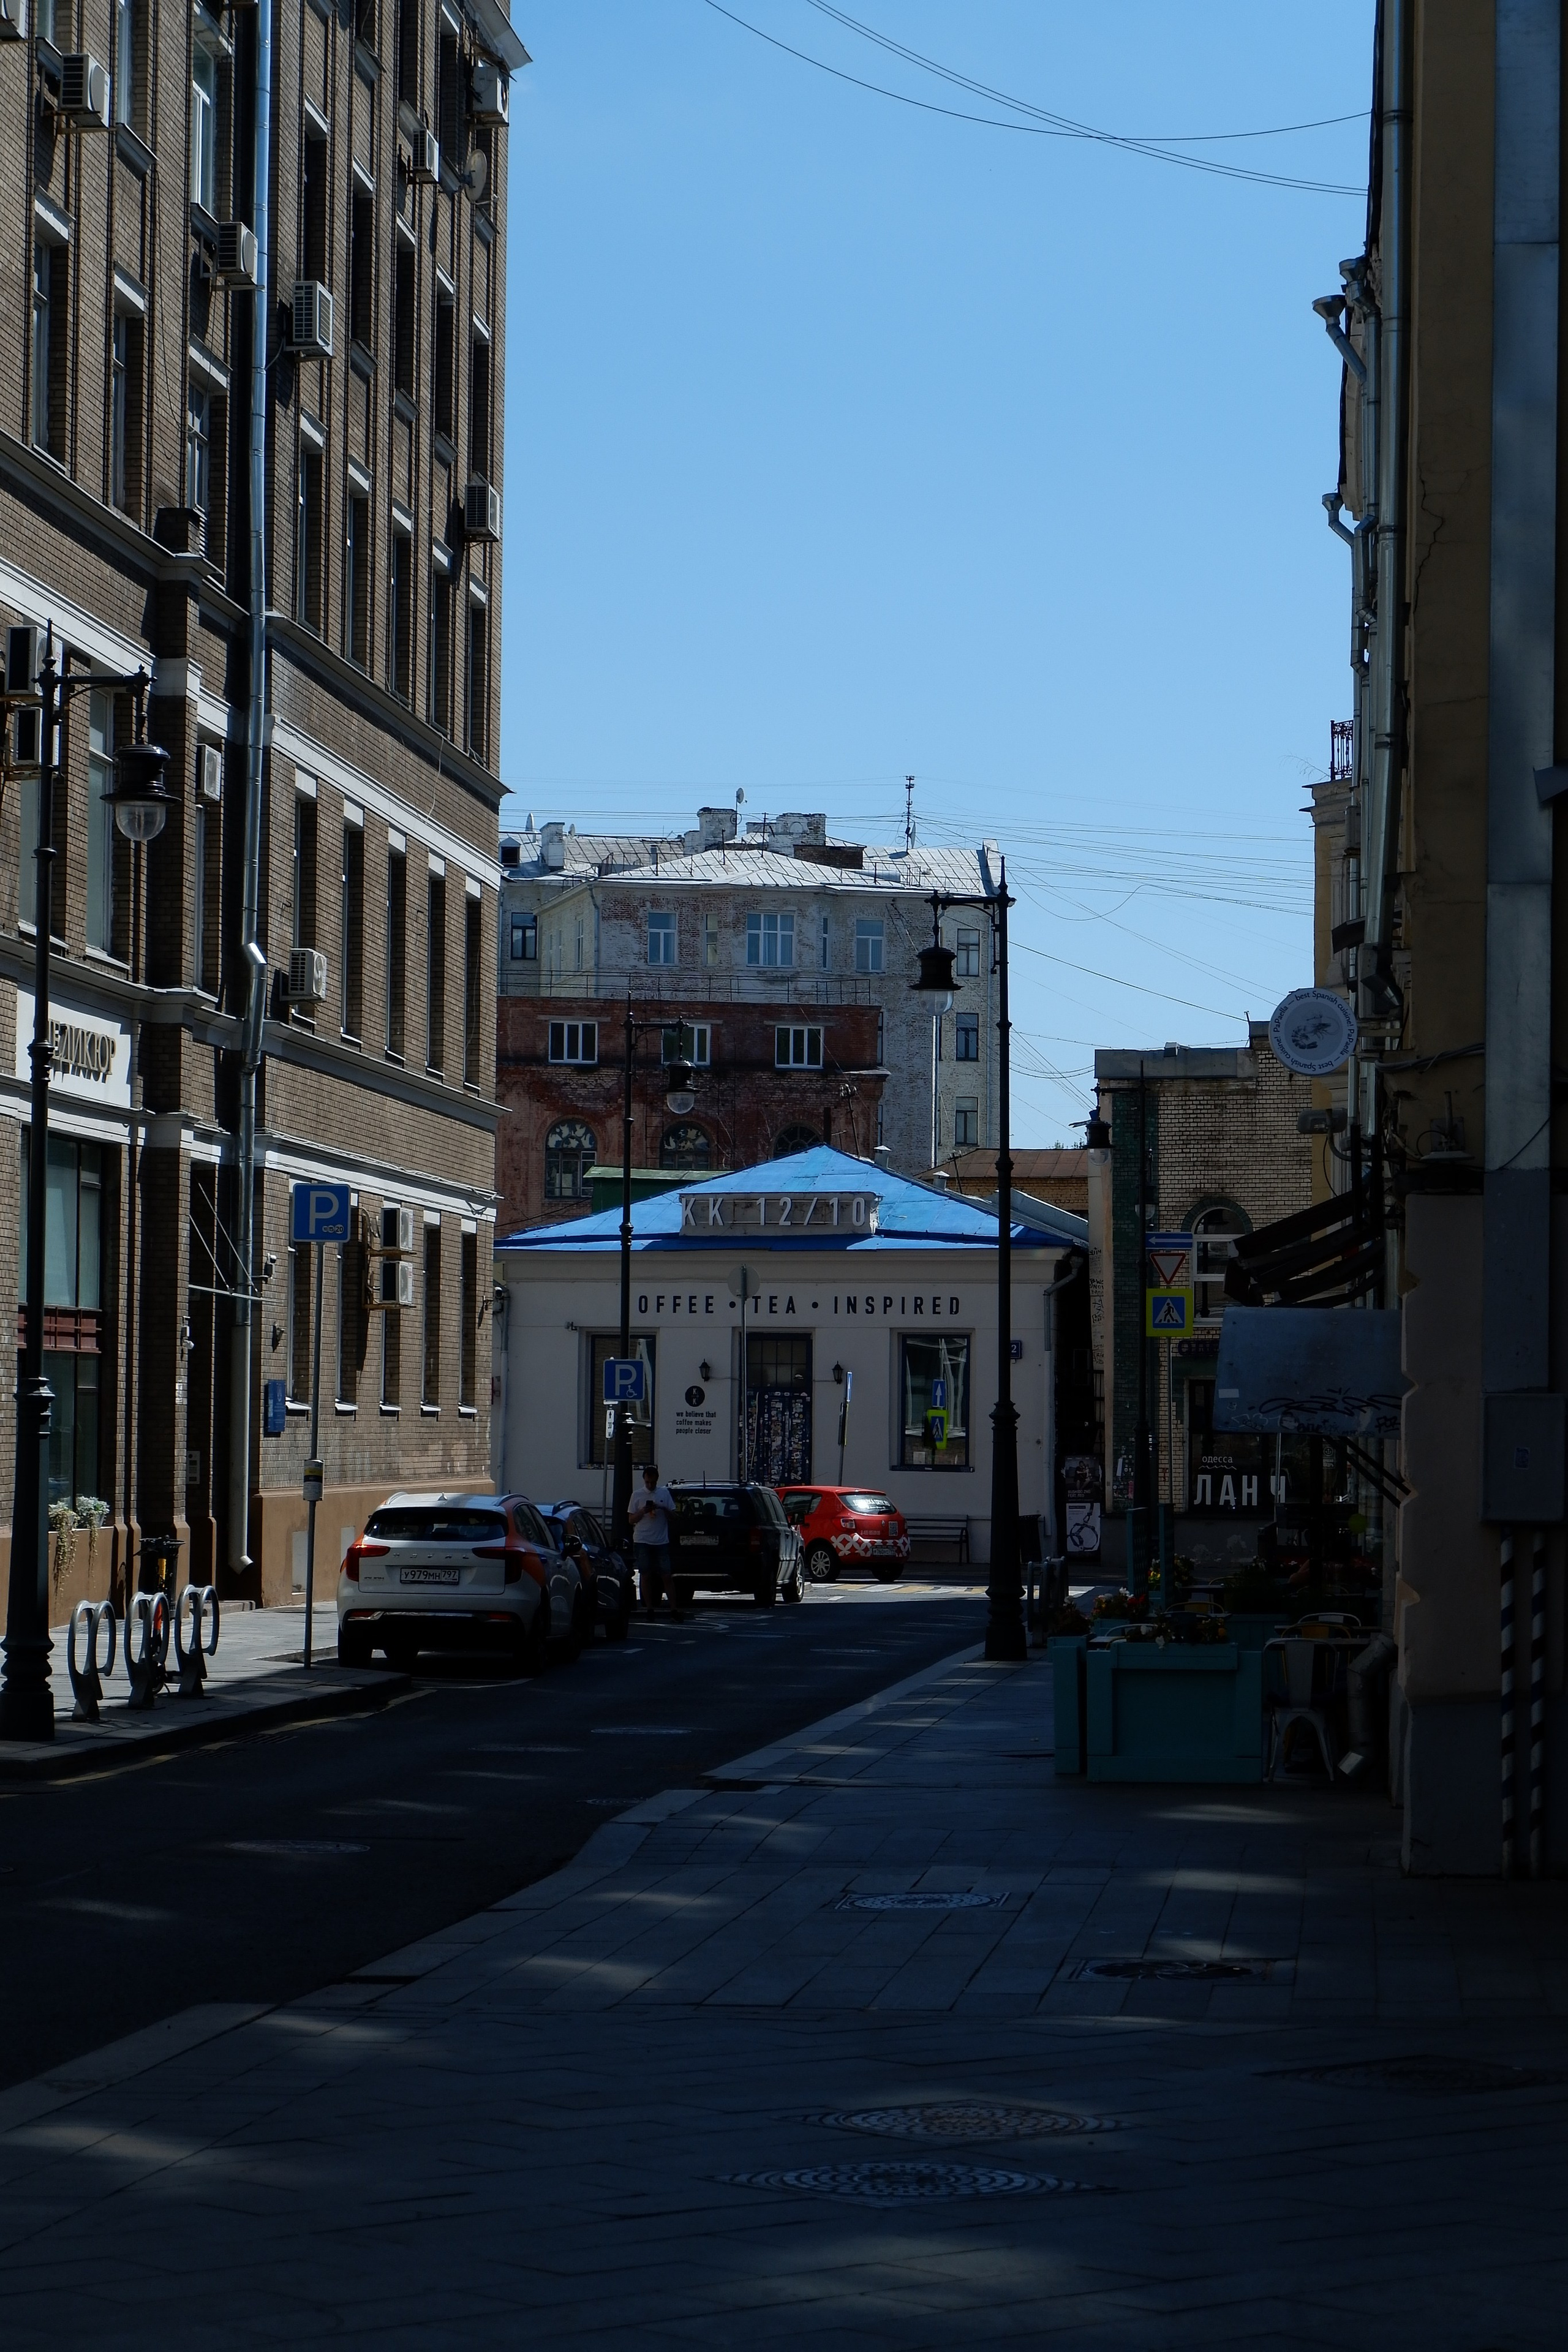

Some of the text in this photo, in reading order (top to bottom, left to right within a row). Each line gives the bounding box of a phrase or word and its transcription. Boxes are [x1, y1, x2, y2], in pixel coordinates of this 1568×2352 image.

[1273, 990, 1354, 1033] PaPaella best Spanish cuisine!
[48, 1019, 116, 1076] ЕДИКЮР
[1291, 1058, 1316, 1071] Spanish
[1318, 1060, 1334, 1069] best
[309, 1191, 339, 1234] P
[756, 1197, 866, 1226] 12/10
[752, 1295, 796, 1314] TEA
[834, 1296, 960, 1315] INSPIRED
[615, 1364, 637, 1396] P
